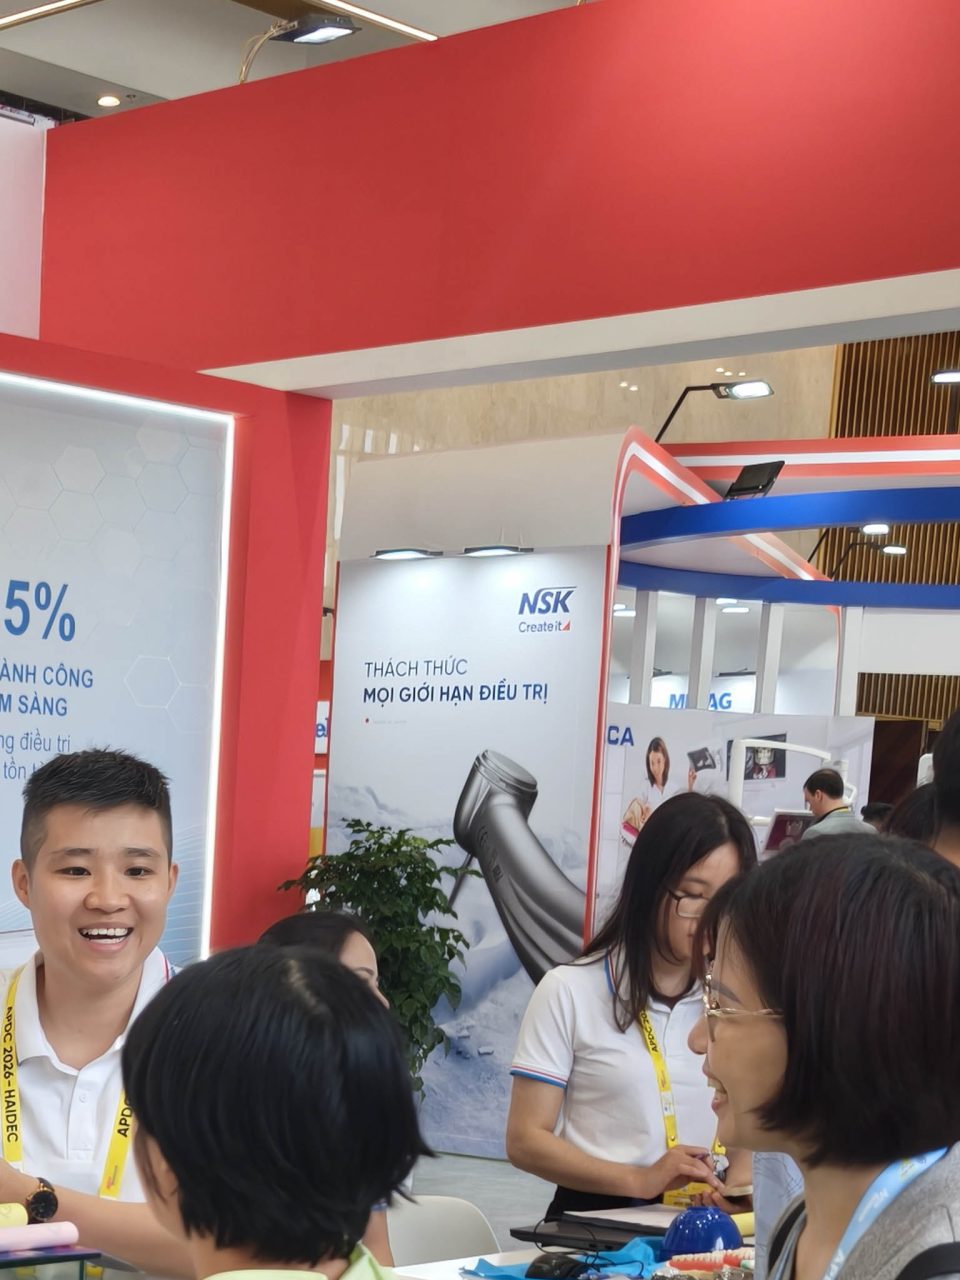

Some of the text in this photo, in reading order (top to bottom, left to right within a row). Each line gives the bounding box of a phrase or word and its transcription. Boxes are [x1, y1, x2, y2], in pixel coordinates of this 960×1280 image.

[518, 586, 578, 615] NSK
[518, 620, 554, 633] Create
[43, 663, 94, 689] CÔNG
[365, 655, 468, 678] THÁCH THỨC
[18, 694, 68, 717] SÀNG
[363, 687, 394, 708] MỌI
[400, 681, 434, 702] GIỚI
[440, 685, 473, 706] HẠN
[523, 683, 548, 704] TRỊ
[20, 728, 51, 752] điều
[4, 757, 26, 780] tồn
[5, 1006, 16, 1043] APDC
[4, 1089, 19, 1143] HAIDEC
